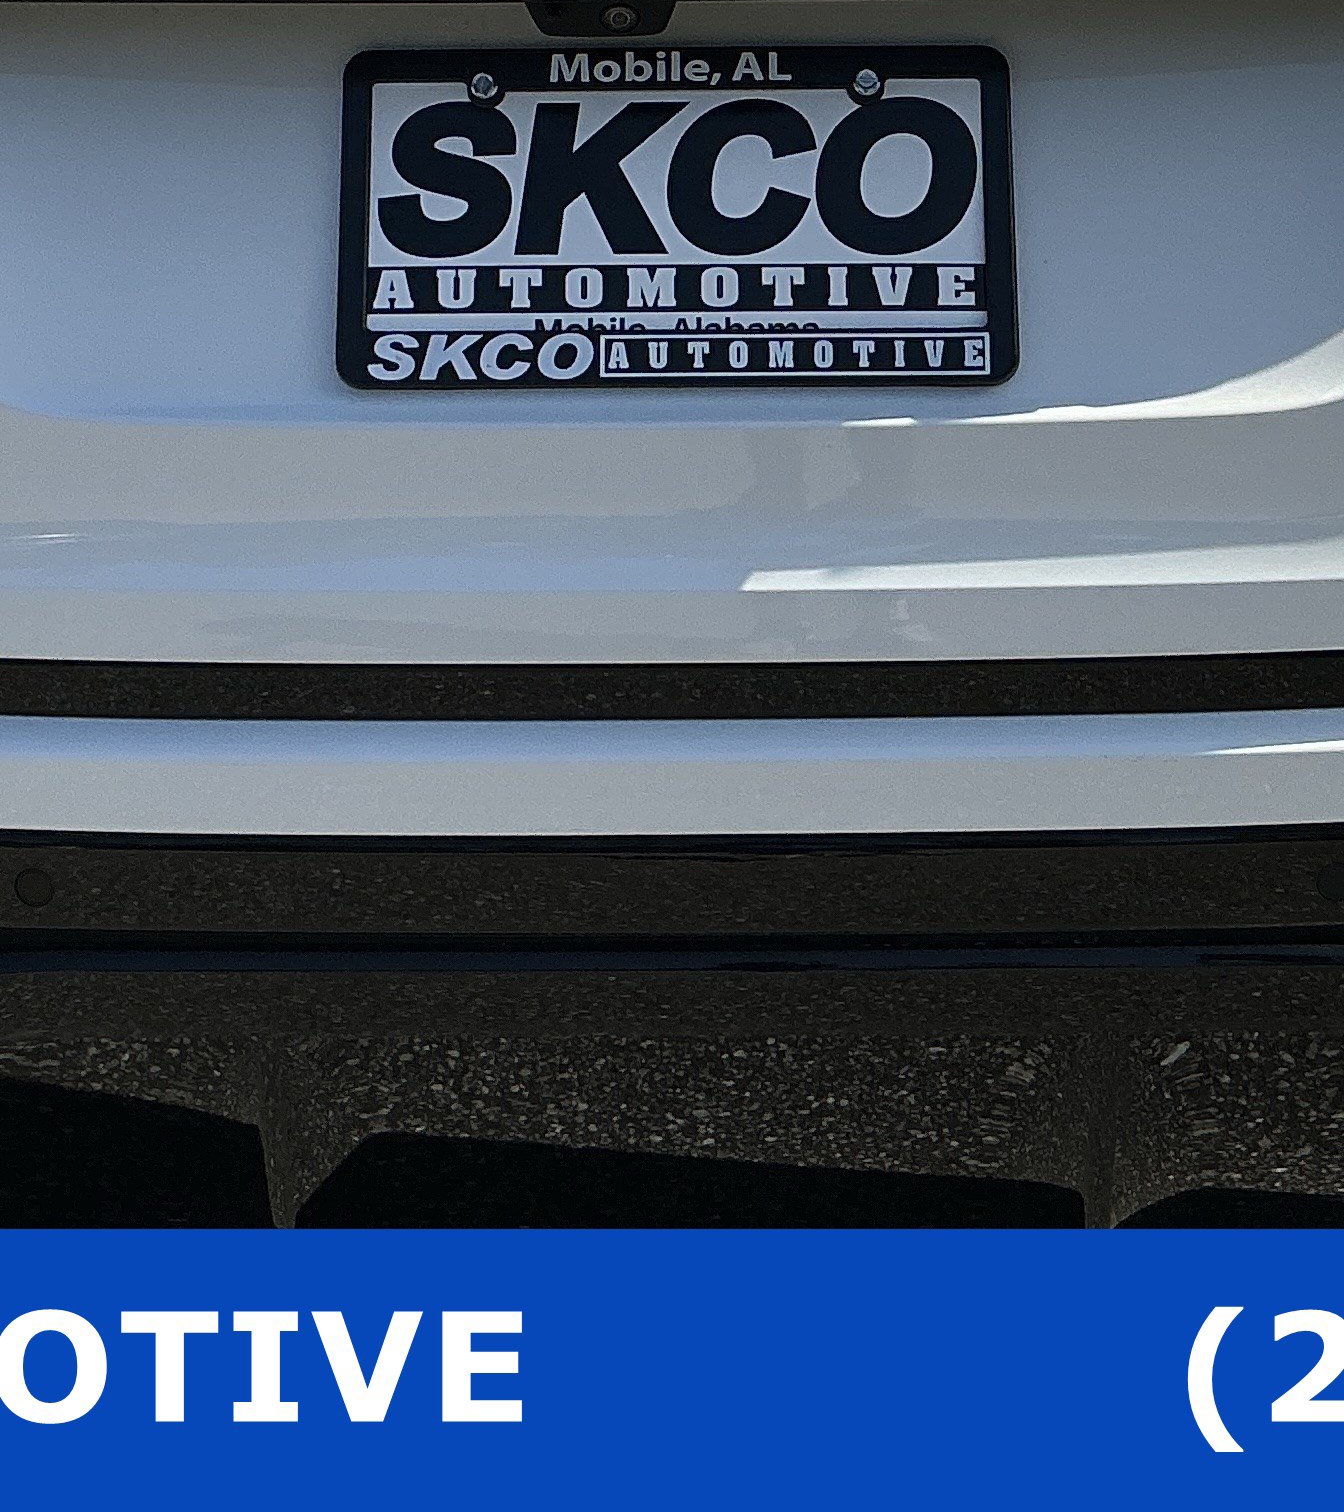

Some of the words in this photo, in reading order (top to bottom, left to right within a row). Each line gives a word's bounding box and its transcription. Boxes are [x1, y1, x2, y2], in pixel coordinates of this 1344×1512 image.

[549, 51, 721, 85] Mobile,
[732, 52, 792, 82] AL
[376, 95, 978, 259] SKCO
[372, 266, 976, 310] AUTOMOTIVE
[367, 332, 595, 381] SKCO
[606, 338, 986, 370] AUTOMOTIVE
